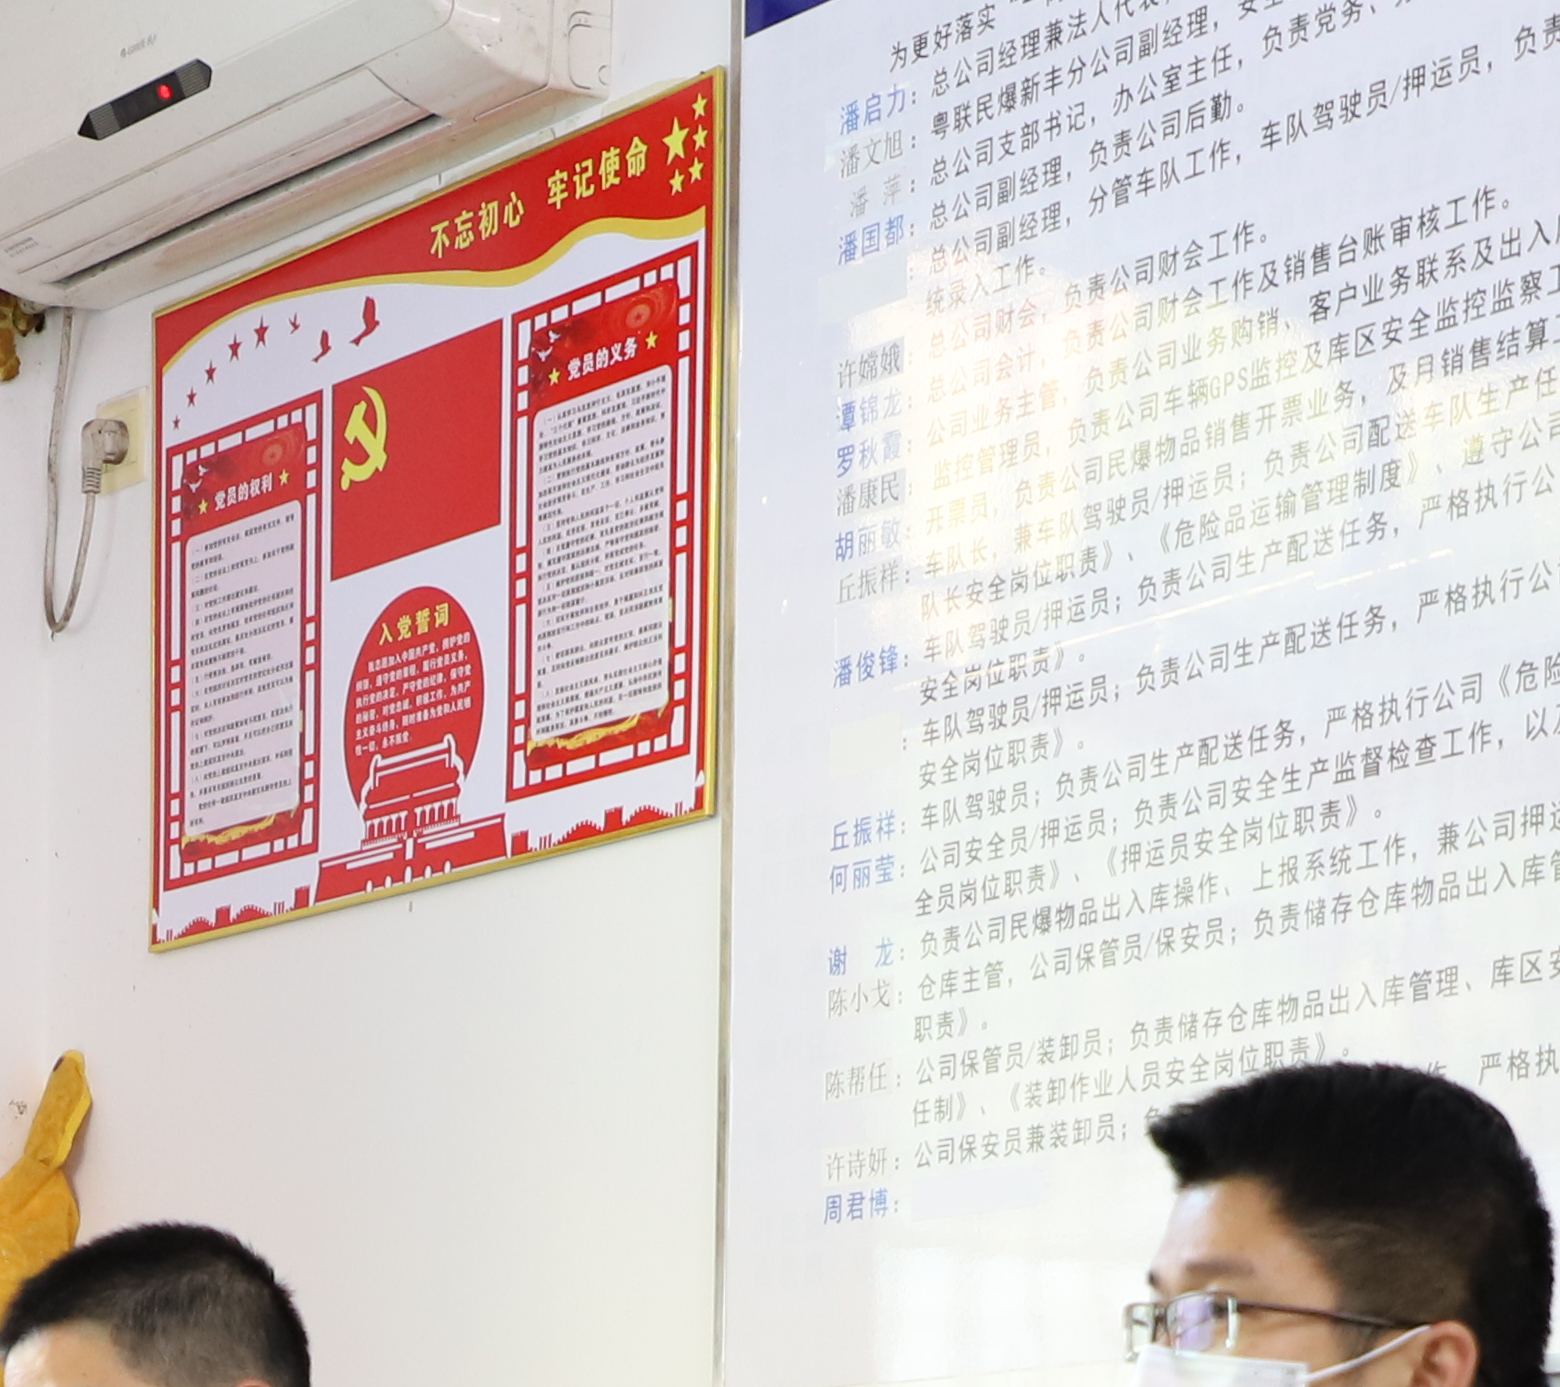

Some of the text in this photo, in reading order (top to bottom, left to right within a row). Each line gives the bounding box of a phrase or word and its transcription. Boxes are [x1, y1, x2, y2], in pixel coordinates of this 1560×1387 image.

[430, 136, 648, 259] 不忘初心 牢记使命
[567, 336, 638, 381] 党员的义务
[379, 602, 450, 645] 入党誓词
